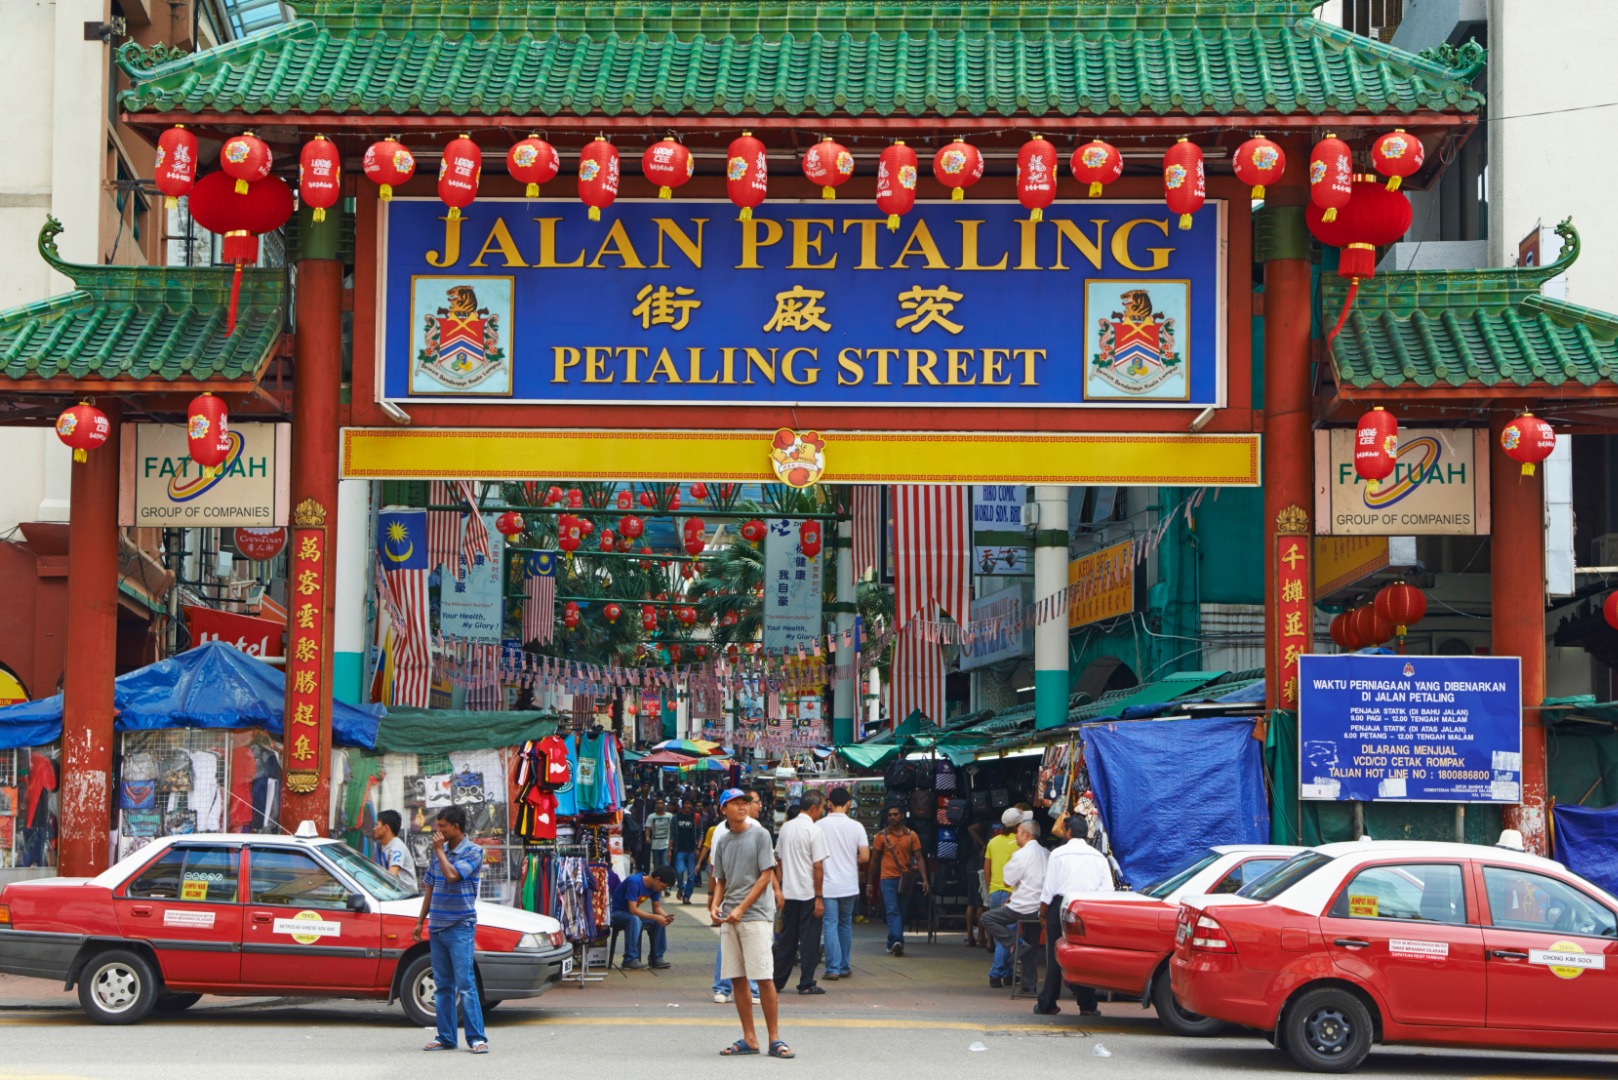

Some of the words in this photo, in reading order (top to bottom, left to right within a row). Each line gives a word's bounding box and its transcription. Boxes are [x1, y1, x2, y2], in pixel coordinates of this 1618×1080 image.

[425, 216, 710, 269] JALAN
[734, 217, 1176, 272] PETALING
[550, 346, 821, 386] PETALING
[837, 348, 1047, 387] STREET
[1339, 463, 1466, 484] FTUAH
[141, 506, 182, 518] GROUP
[186, 506, 200, 517] OF
[203, 506, 270, 518] COMPANIES
[1336, 514, 1379, 525] GROUP
[1382, 514, 1397, 525] OF
[1401, 514, 1470, 525] COMPANIES
[200, 632, 269, 657] Htel
[1313, 680, 1347, 690] WAKTU
[1350, 680, 1410, 691] PERNIAGAAN
[1415, 681, 1440, 691] YANG
[1444, 681, 1506, 692] DIBENARKAN
[1362, 692, 1371, 701] DI
[1375, 692, 1406, 702] JALAN
[1409, 693, 1454, 703] PETALING
[1362, 744, 1410, 755] DILARANG
[1414, 745, 1457, 755] MENJUAL
[1353, 756, 1388, 766] VCD/CD
[1392, 757, 1421, 766] CETAK
[1426, 757, 1465, 768] ROMPAK
[1329, 768, 1362, 778] TALIAN
[1366, 768, 1384, 778] HOT
[1388, 769, 1408, 779] LINE
[1412, 769, 1426, 779] NO
[1438, 770, 1489, 780] 1800886800
